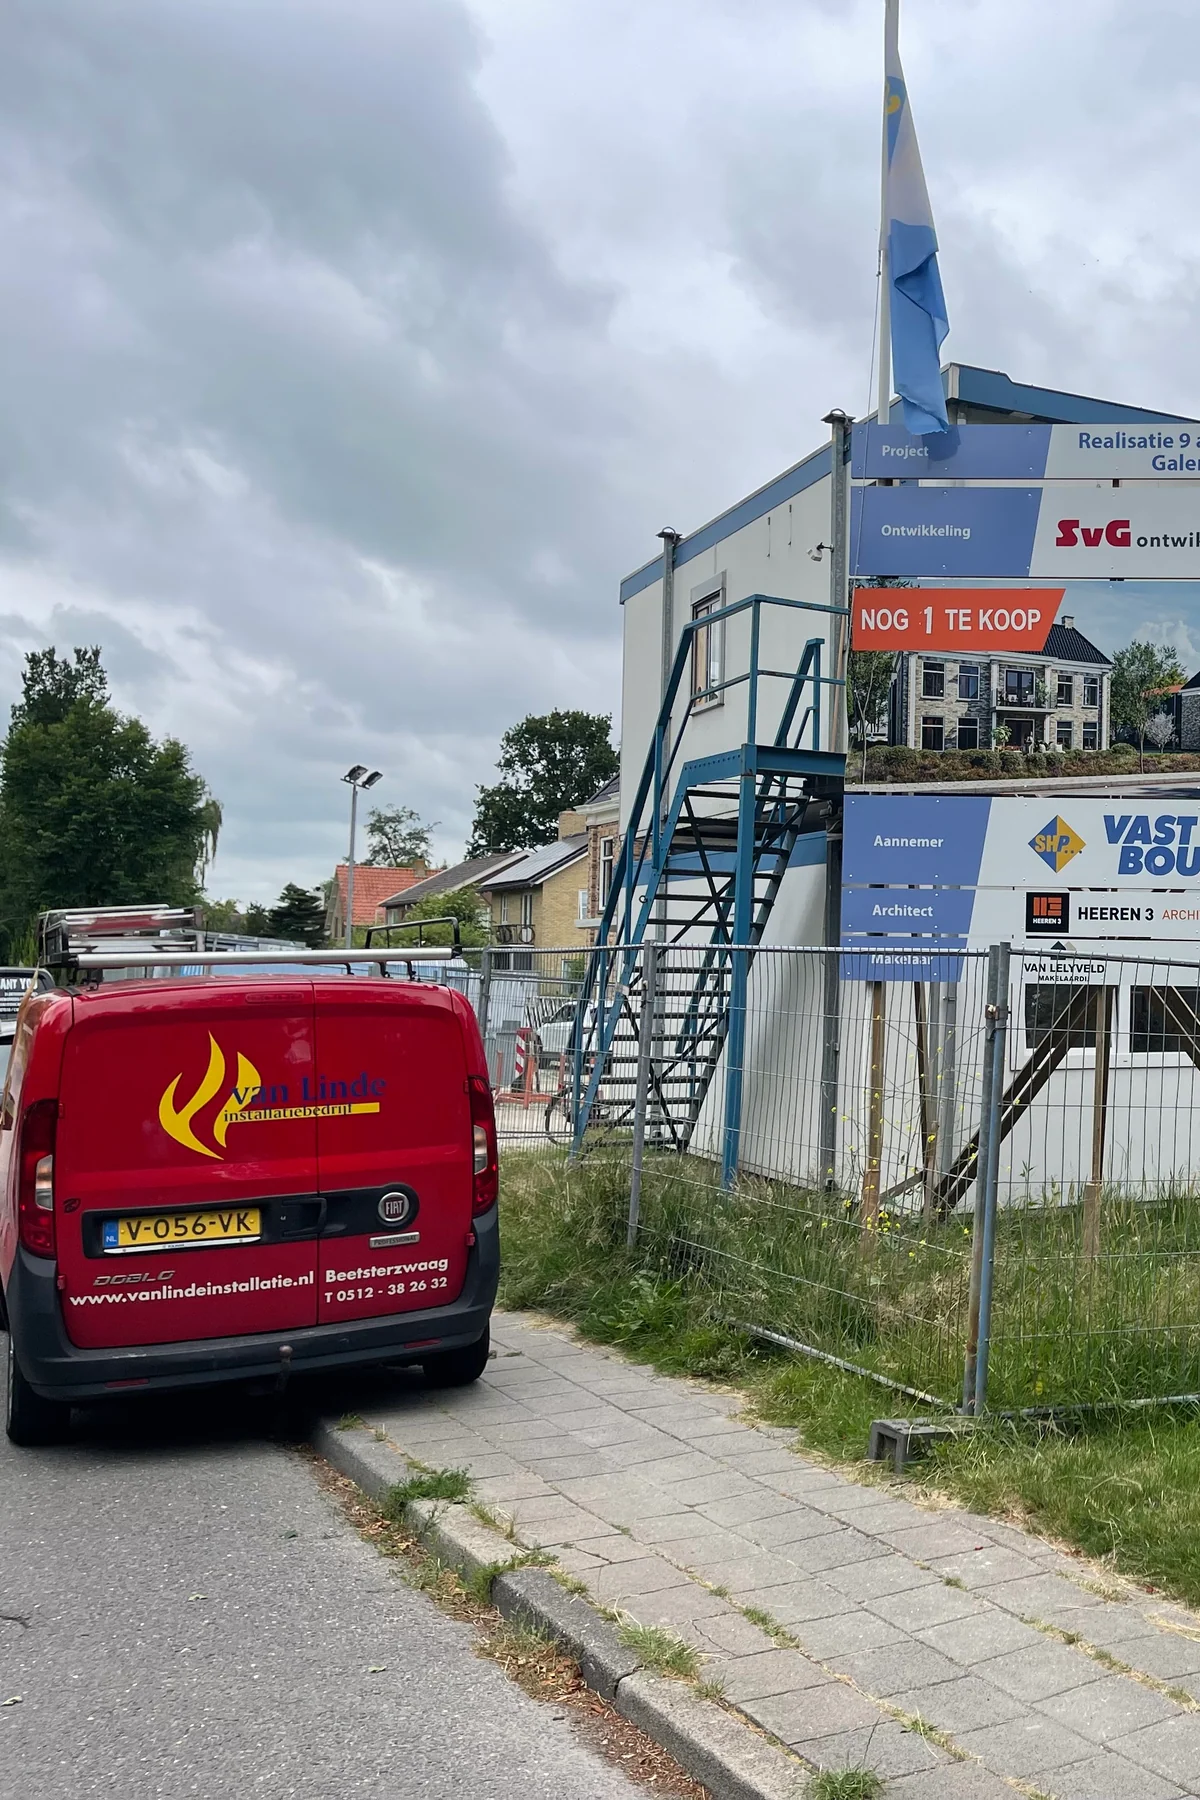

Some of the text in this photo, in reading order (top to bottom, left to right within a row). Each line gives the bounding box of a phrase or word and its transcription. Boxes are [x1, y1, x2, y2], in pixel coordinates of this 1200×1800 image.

[1078, 432, 1174, 449] Realisatie
[1179, 433, 1191, 448] 9
[881, 445, 929, 458] Project
[881, 525, 971, 540] Ontwikkeling
[1055, 519, 1131, 547] SvG
[861, 606, 1041, 634] NOG 1 TE KOOP
[1103, 815, 1198, 845] VAST
[874, 835, 944, 848] Aannemer
[872, 904, 934, 917] Architect
[1078, 907, 1140, 920] HEEREN
[1145, 908, 1154, 921] 3
[1024, 963, 1105, 973] VAN LELYVELD
[0, 978, 17, 990] ANT
[231, 1072, 387, 1105] van Linde
[386, 1200, 403, 1215] FIAT
[126, 1212, 252, 1241] V-056-VK
[93, 1271, 175, 1286] DOBLO
[325, 1258, 449, 1283] Beetsterzwaag
[69, 1271, 314, 1306] www.vanlindeinstallatie.nl
[325, 1292, 333, 1303] T
[336, 1287, 374, 1302] 0512
[387, 1283, 405, 1296] 38
[409, 1280, 427, 1292] 26
[431, 1277, 448, 1290] 32
